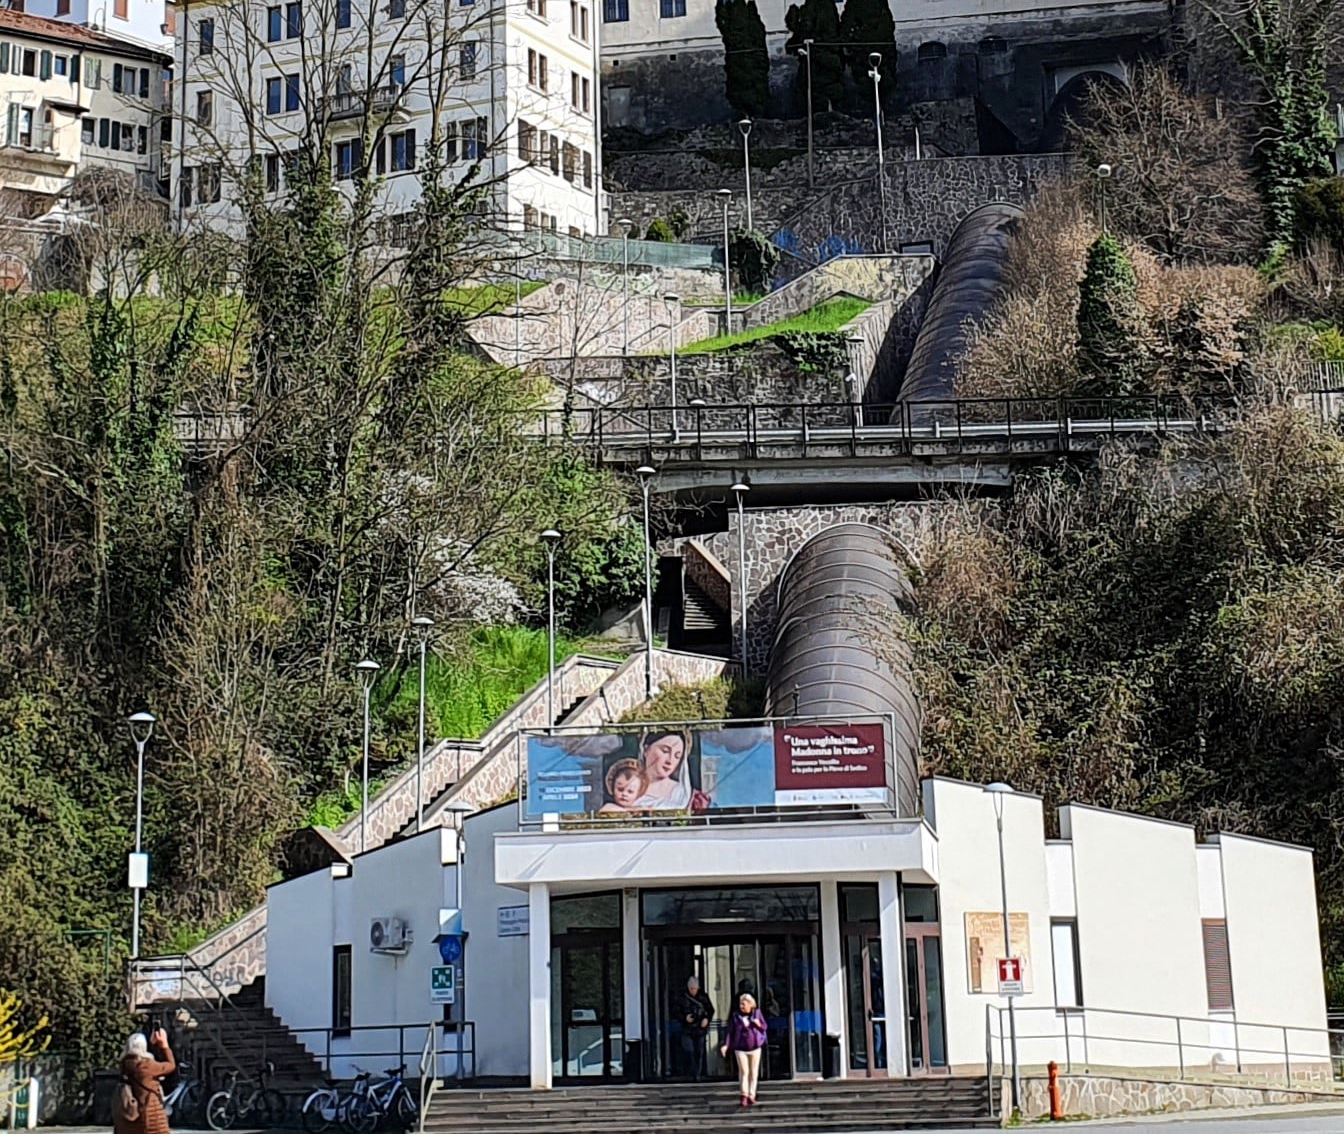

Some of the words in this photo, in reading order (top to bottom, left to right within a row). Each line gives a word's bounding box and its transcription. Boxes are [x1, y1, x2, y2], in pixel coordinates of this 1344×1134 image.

[810, 735, 858, 747] vaghissima
[791, 747, 832, 756] Madonna
[833, 746, 842, 755] in
